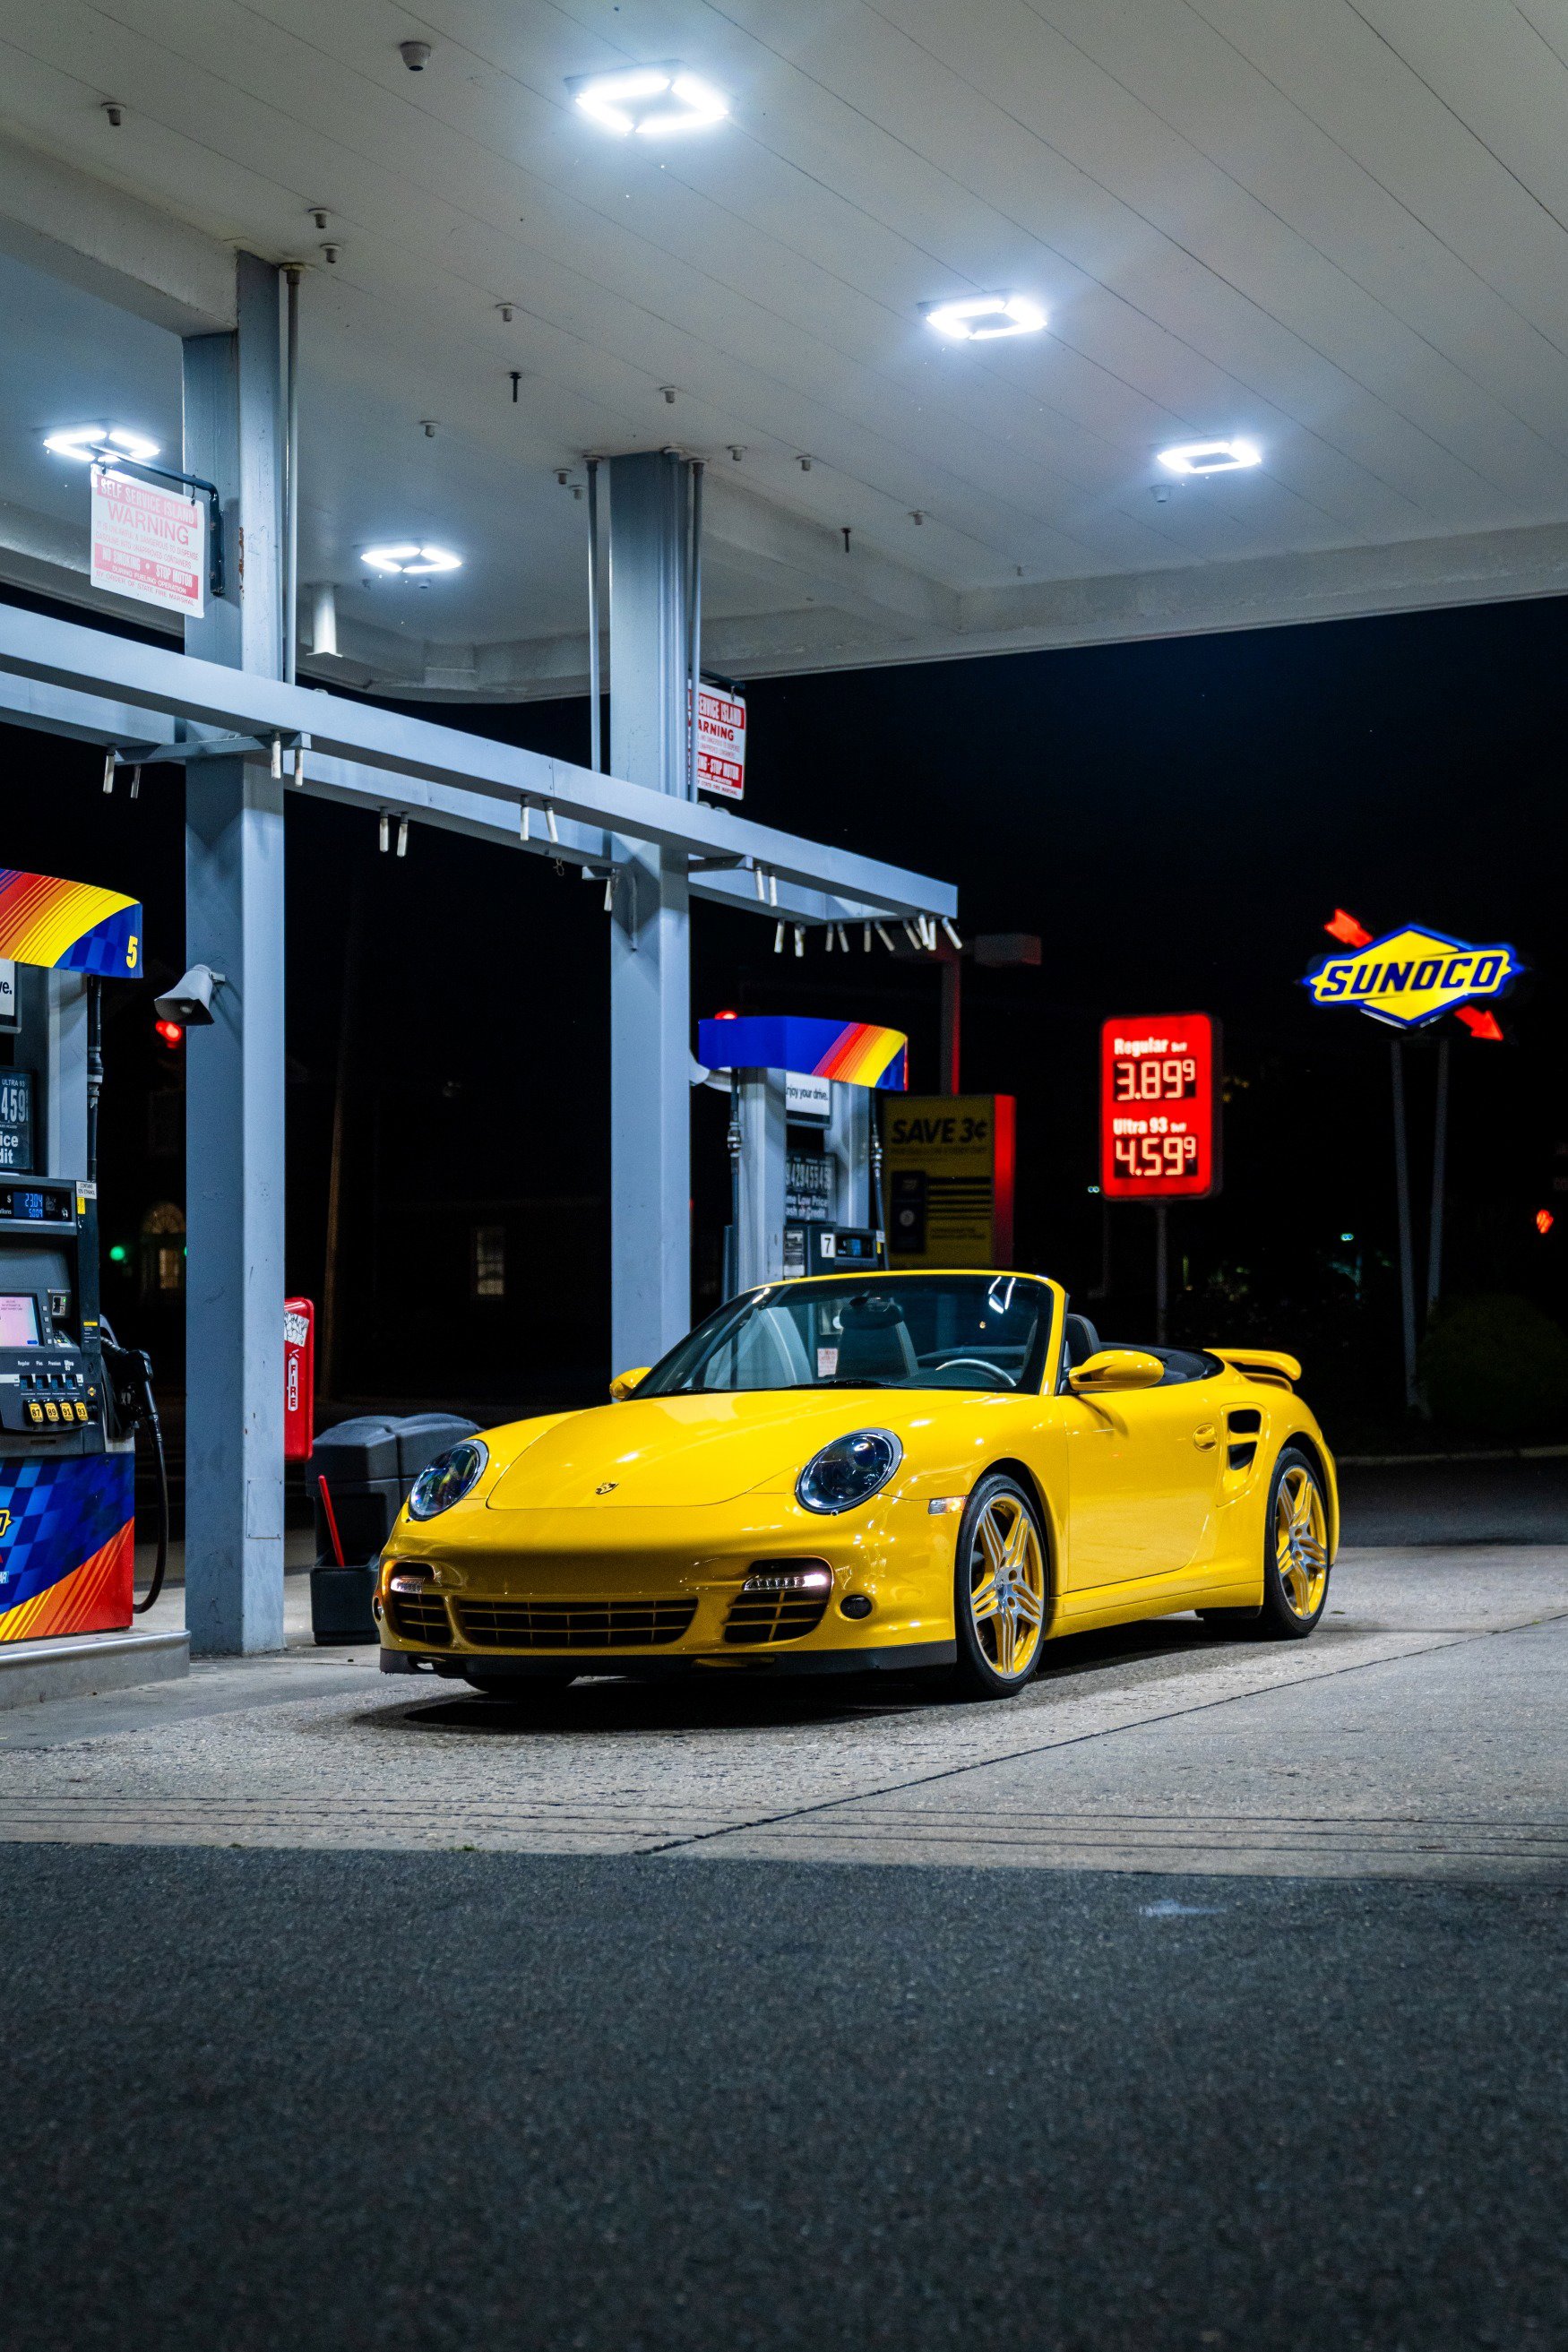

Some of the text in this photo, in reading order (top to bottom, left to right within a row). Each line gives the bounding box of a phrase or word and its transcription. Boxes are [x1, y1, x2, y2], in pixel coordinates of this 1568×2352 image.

[100, 478, 194, 525] SELF SERVICE ISLAND
[108, 500, 189, 547] WARNING
[102, 547, 111, 562] NO
[155, 564, 171, 581] STOP
[172, 569, 193, 588] MOTOR
[112, 565, 186, 595] DURING FUELING OPERATION
[168, 590, 194, 606] MARSHAL
[698, 719, 734, 741] ARNING
[125, 935, 138, 969] 5
[1321, 956, 1503, 996] SUNOCO
[1114, 1037, 1169, 1057] Regular
[2, 1078, 18, 1087] ULTRA
[786, 1085, 798, 1099] njoy
[799, 1088, 812, 1099] your
[892, 1118, 956, 1144] SAVE
[1112, 1118, 1148, 1135] Ultra
[1150, 1116, 1168, 1134] 93
[0, 1131, 19, 1147] ice
[0, 1148, 13, 1164] dit
[824, 1237, 831, 1254] 7
[77, 1408, 86, 1416] 93
